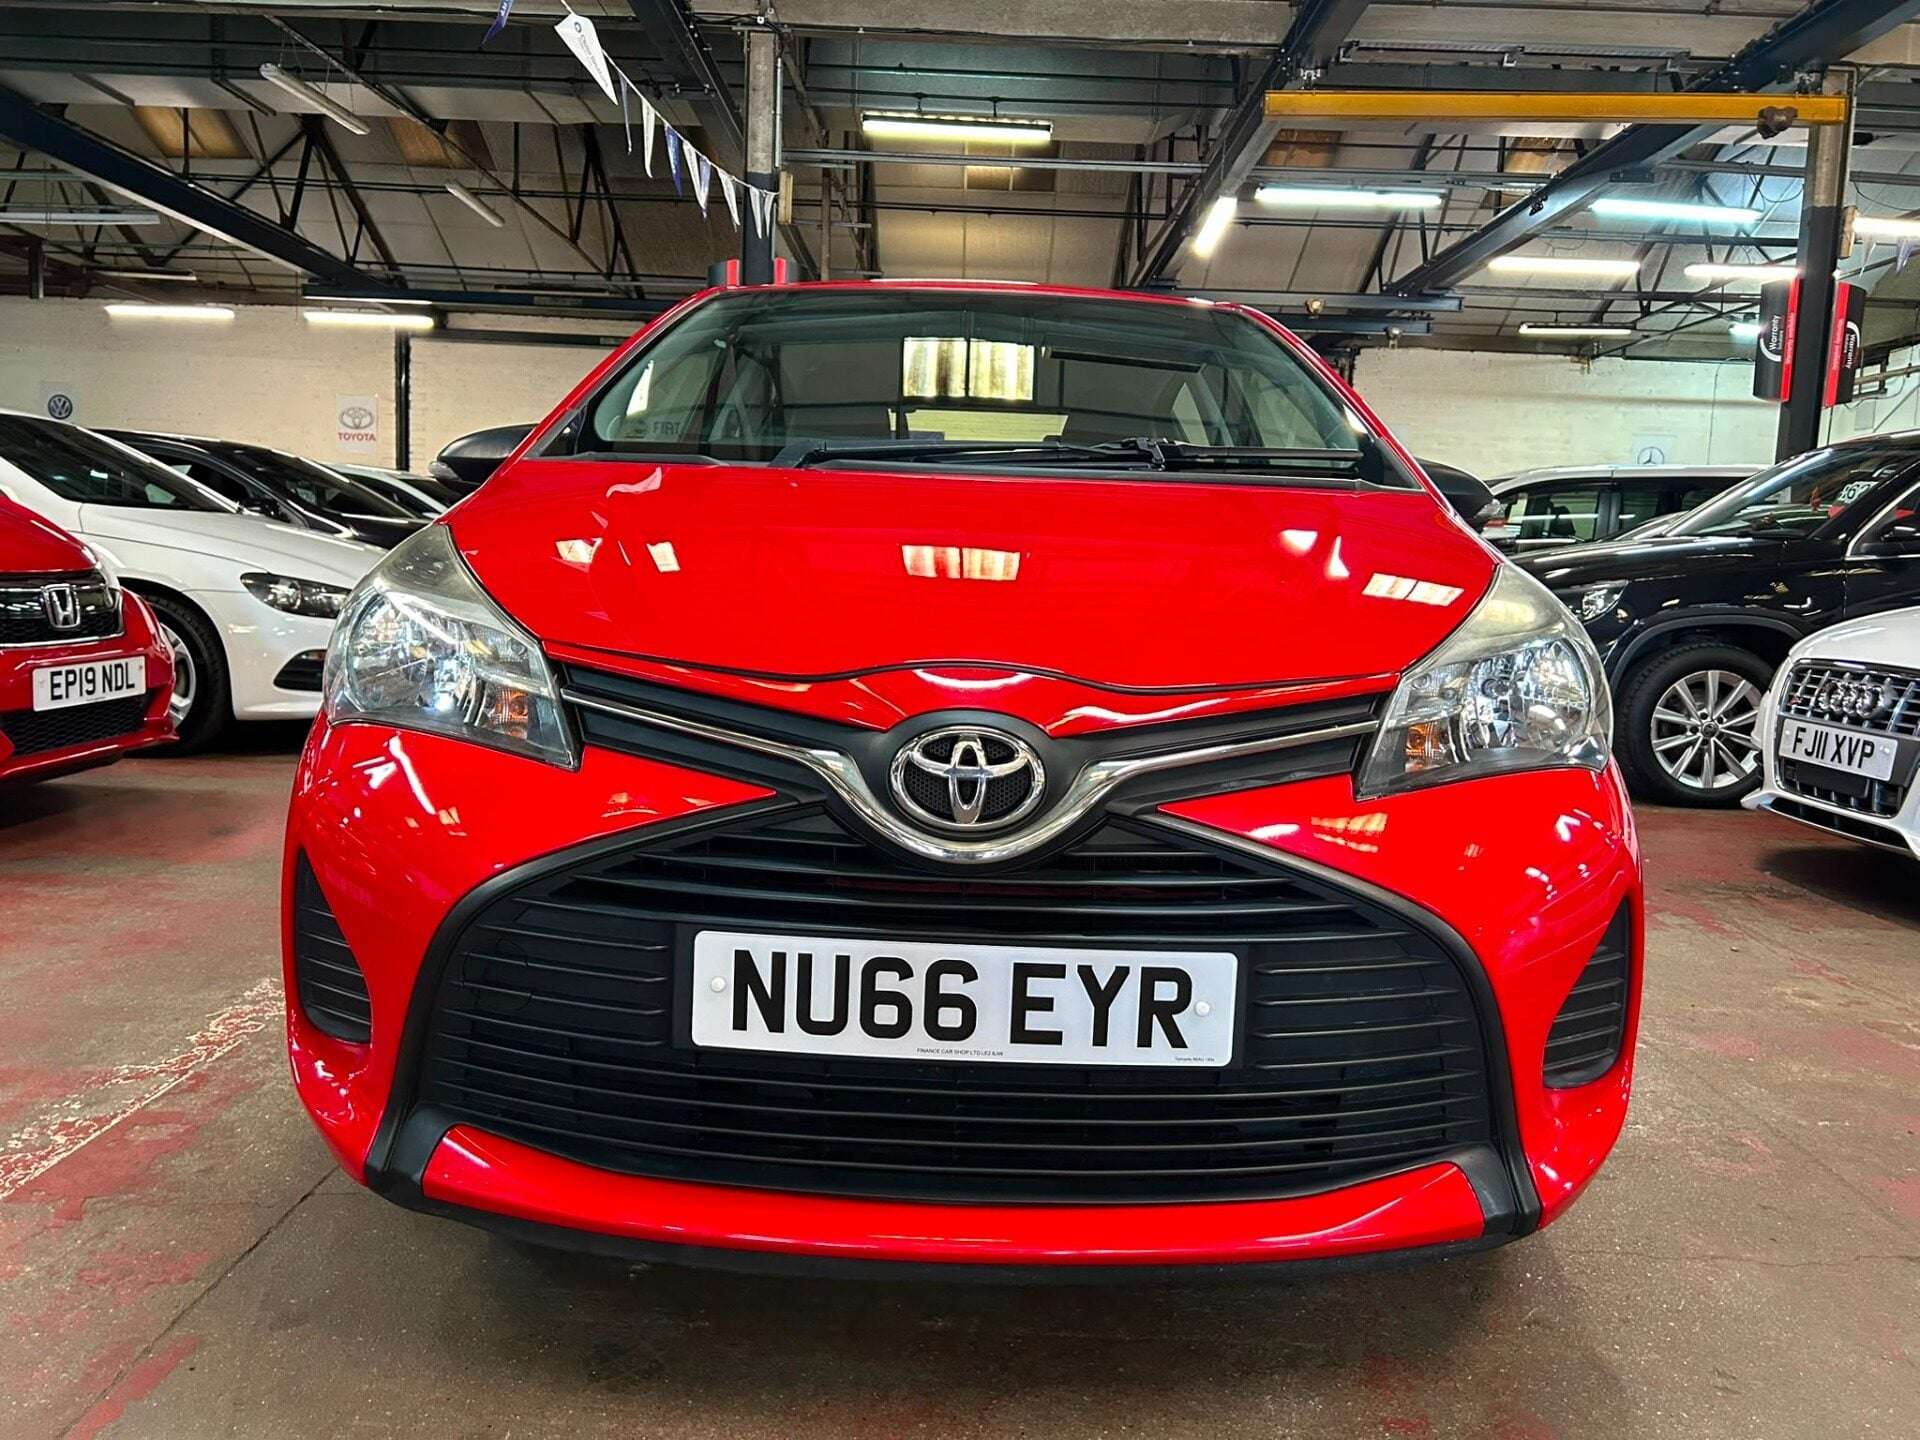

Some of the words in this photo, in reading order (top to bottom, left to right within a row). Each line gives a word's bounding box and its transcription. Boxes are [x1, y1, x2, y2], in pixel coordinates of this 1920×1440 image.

[1768, 315, 1781, 351] Warranty
[1846, 334, 1857, 369] Warranty
[338, 432, 376, 442] TOYOTA
[50, 667, 96, 701] EP19
[102, 662, 135, 693] NDL
[1792, 726, 1829, 760] FJ11
[1830, 734, 1875, 768] XVP
[732, 949, 979, 1042] NU66
[1009, 962, 1194, 1049] EYR
